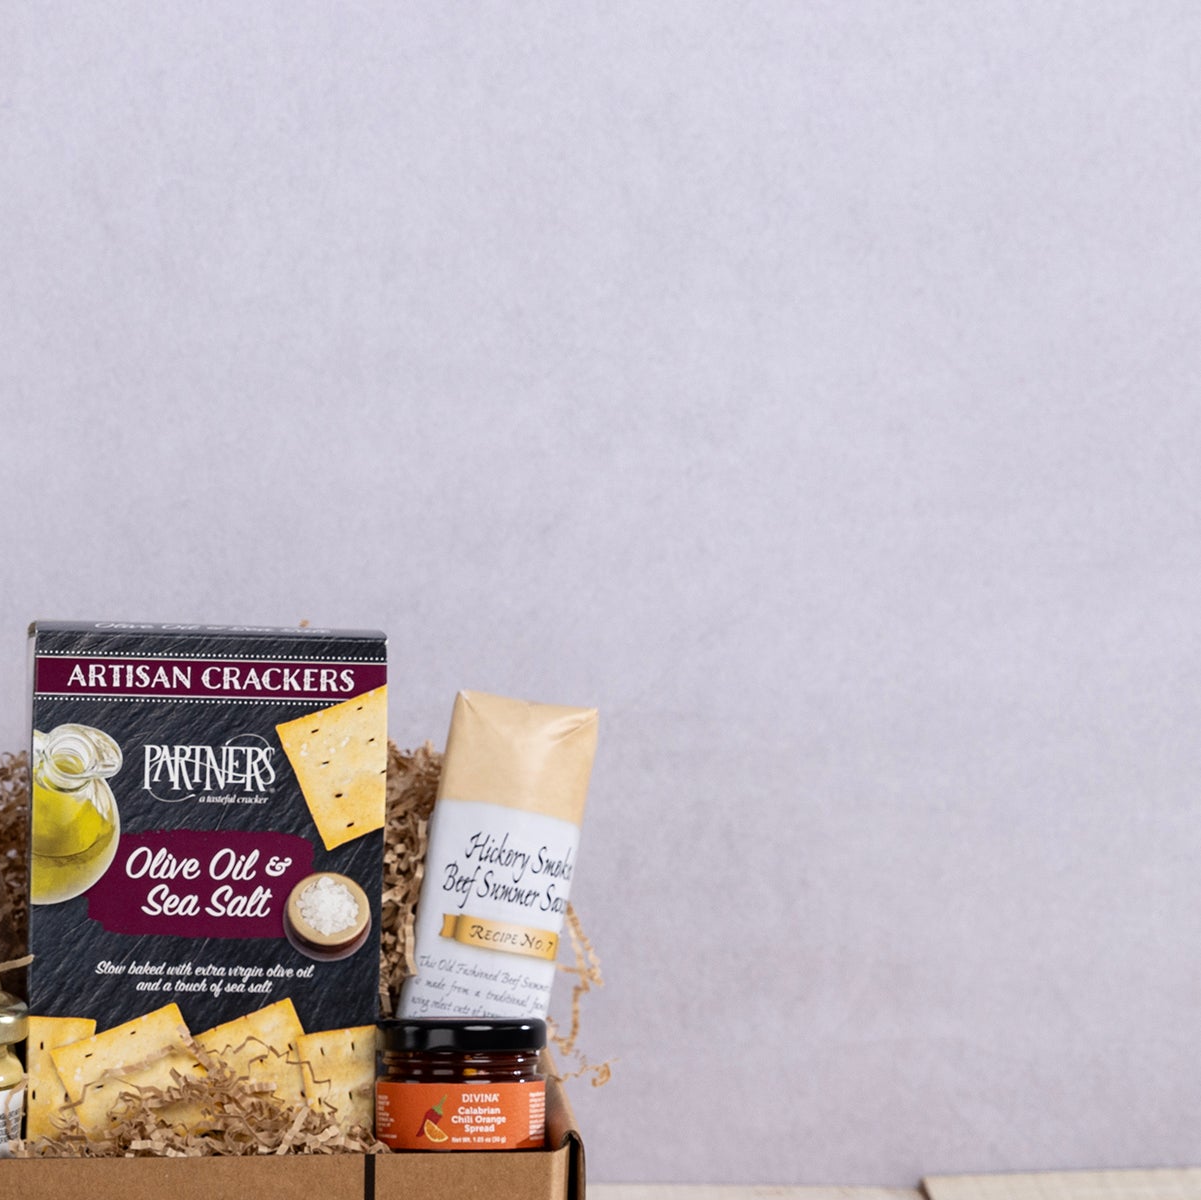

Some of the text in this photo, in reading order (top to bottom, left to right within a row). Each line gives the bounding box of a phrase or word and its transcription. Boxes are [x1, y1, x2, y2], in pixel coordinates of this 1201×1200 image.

[67, 664, 356, 692] ARTISAN CRACKERS
[142, 740, 276, 795] PARTNERS
[206, 794, 237, 805] tasteful
[237, 795, 269, 804] cracker
[125, 846, 293, 881] Olive Oil &
[465, 831, 531, 883] Hickory
[442, 860, 482, 909] Beef
[476, 869, 540, 907] Summer
[140, 883, 274, 918] Sea Salt
[95, 960, 315, 983] Slow baked with extra virgin olive oil
[136, 978, 273, 998] and a touch of sea salt
[462, 1093, 500, 1103] DIVINA
[451, 1115, 507, 1126] Chili Orange
[457, 1105, 501, 1115] Calabrian
[464, 1123, 495, 1134] Spread
